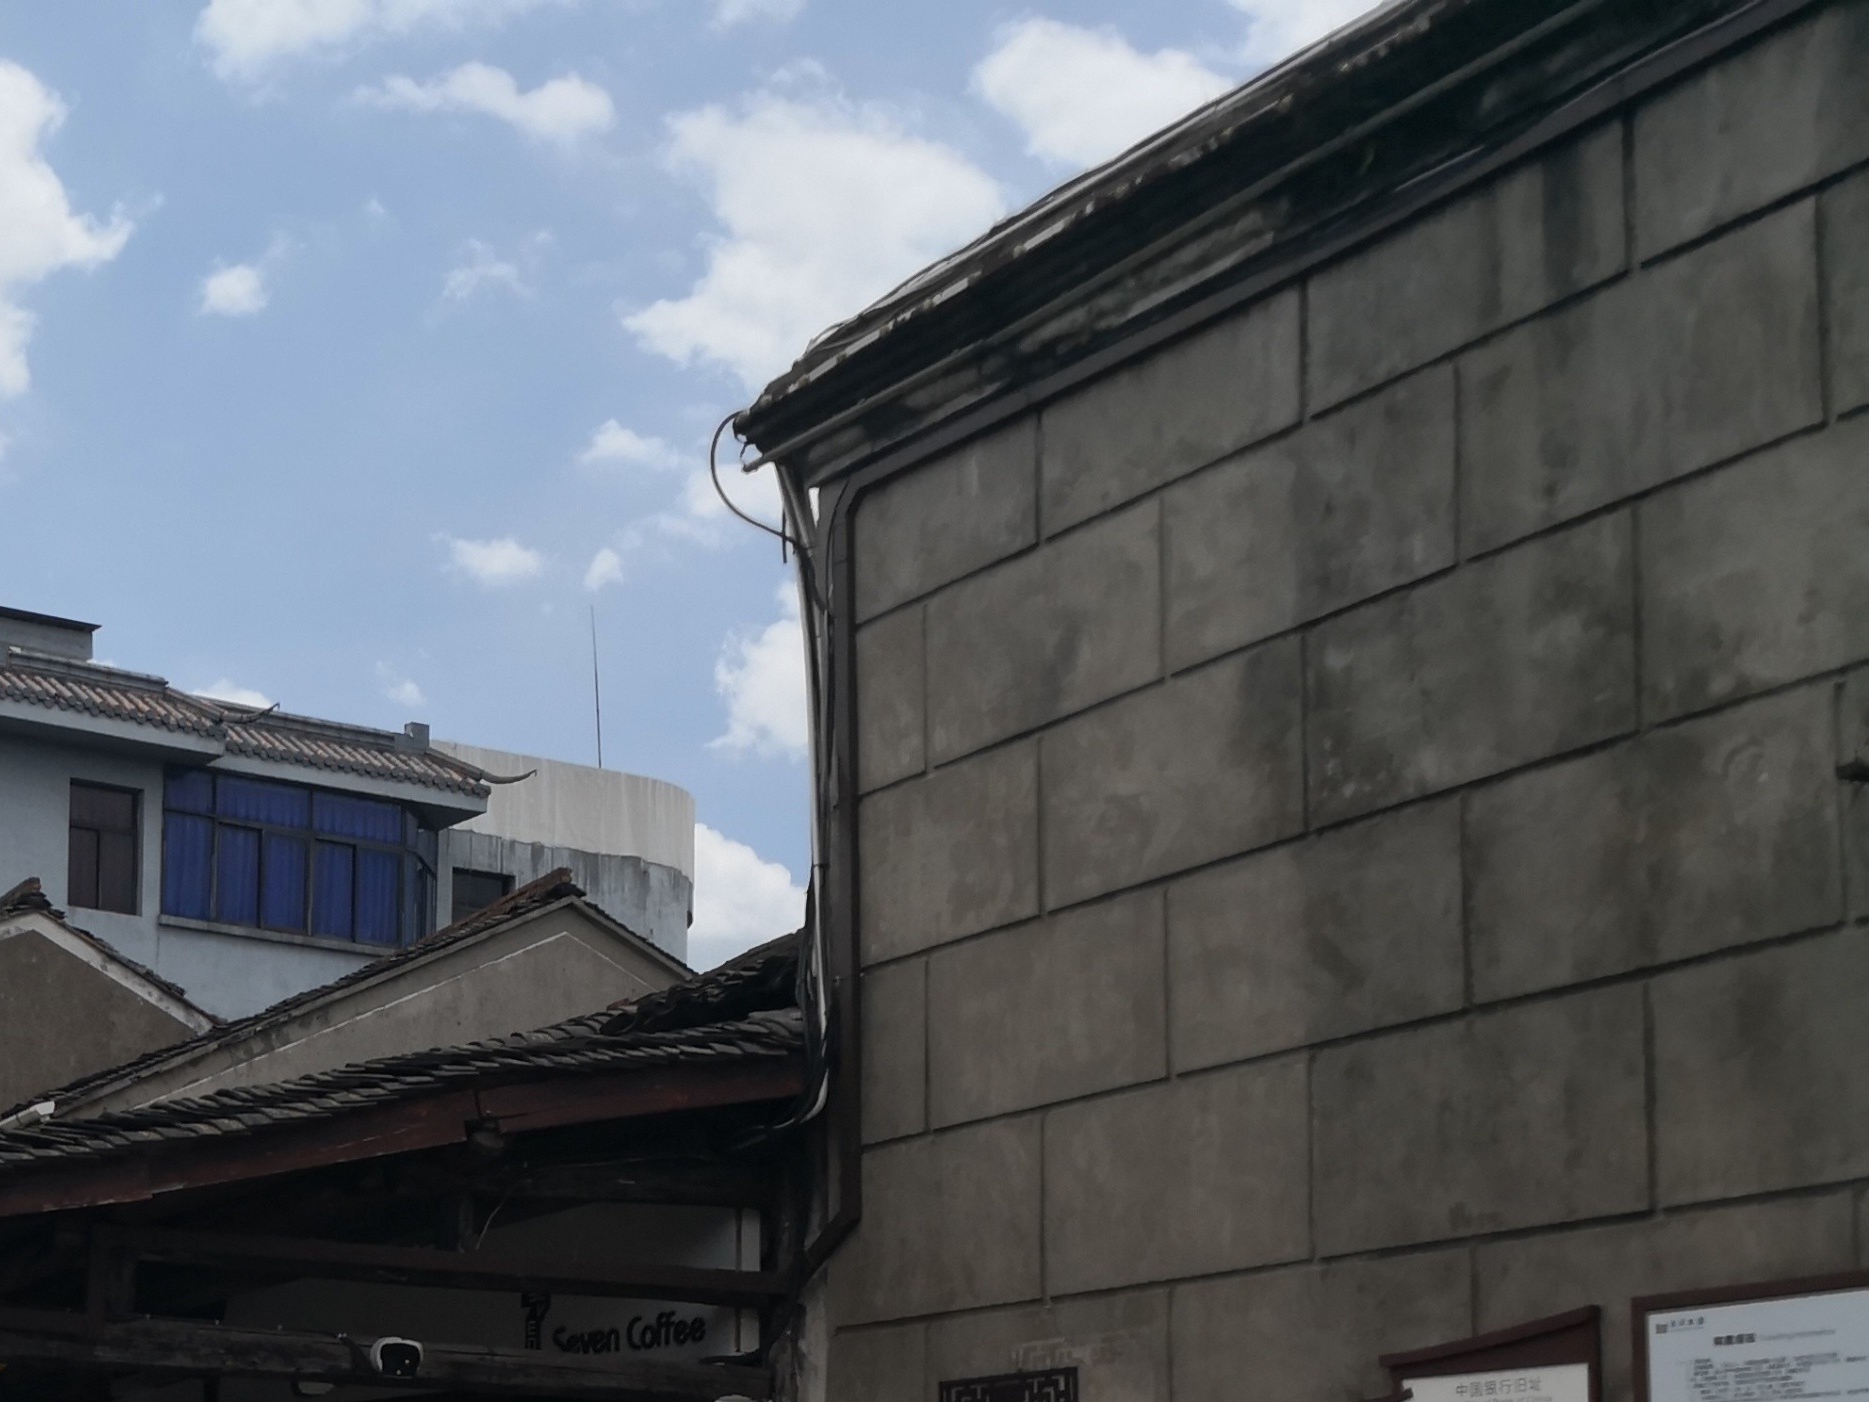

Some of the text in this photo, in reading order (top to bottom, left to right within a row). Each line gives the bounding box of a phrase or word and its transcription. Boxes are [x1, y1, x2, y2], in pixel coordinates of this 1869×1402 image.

[627, 1311, 707, 1350] Coffee
[1455, 1377, 1542, 1398] 中国银行旧址
